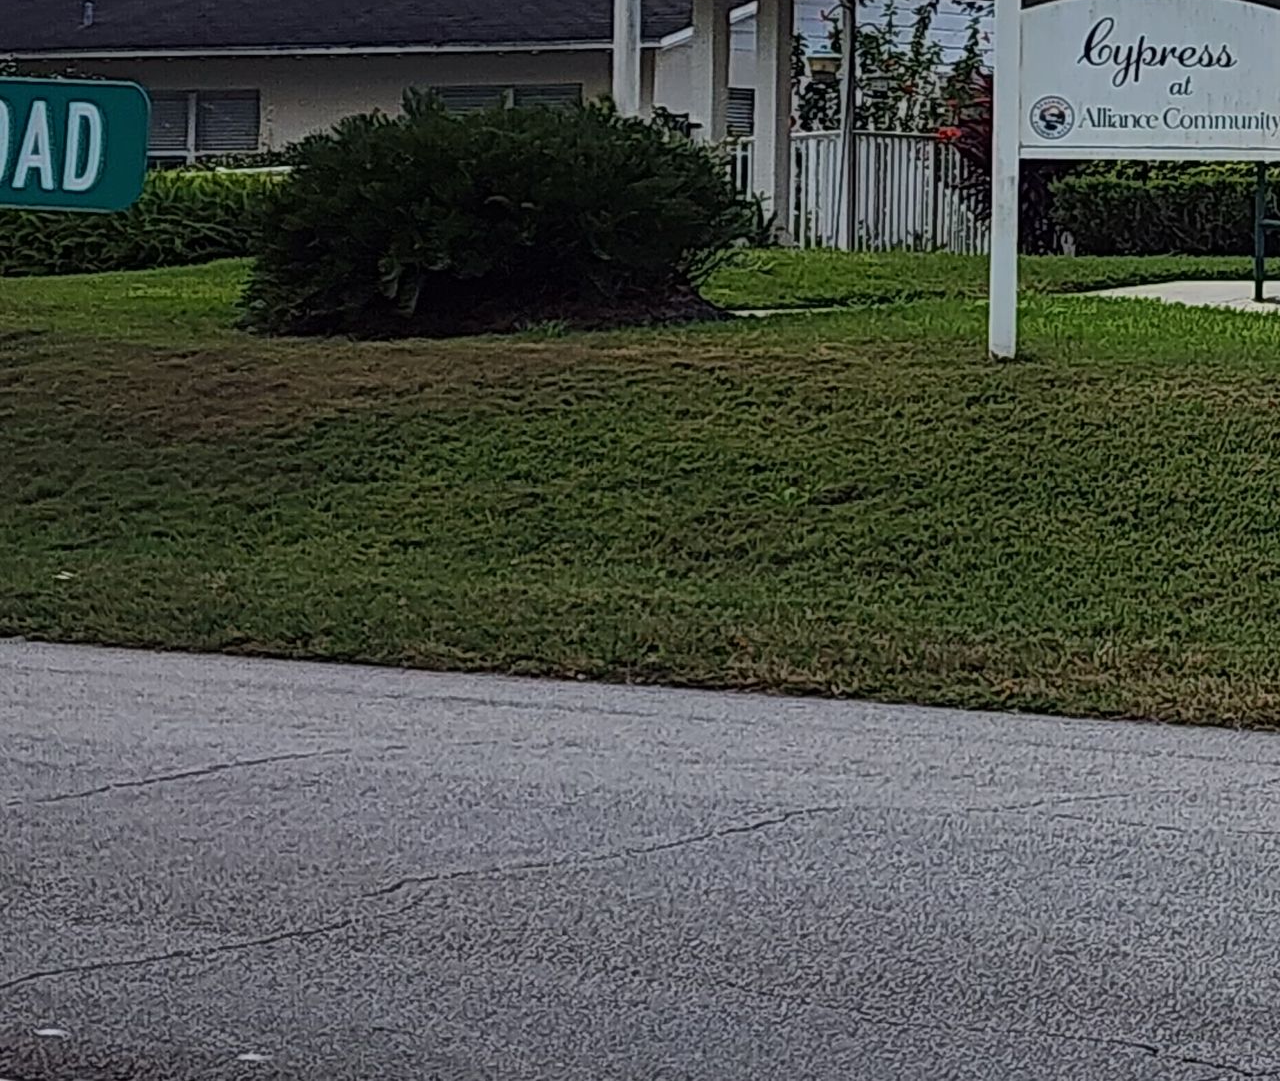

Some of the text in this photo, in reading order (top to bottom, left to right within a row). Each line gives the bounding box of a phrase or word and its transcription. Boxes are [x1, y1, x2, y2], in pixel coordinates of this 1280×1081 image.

[1077, 17, 1237, 87] Cypress
[1169, 75, 1193, 96] at
[1078, 107, 1159, 130] Alliance
[0, 99, 102, 192] AD
